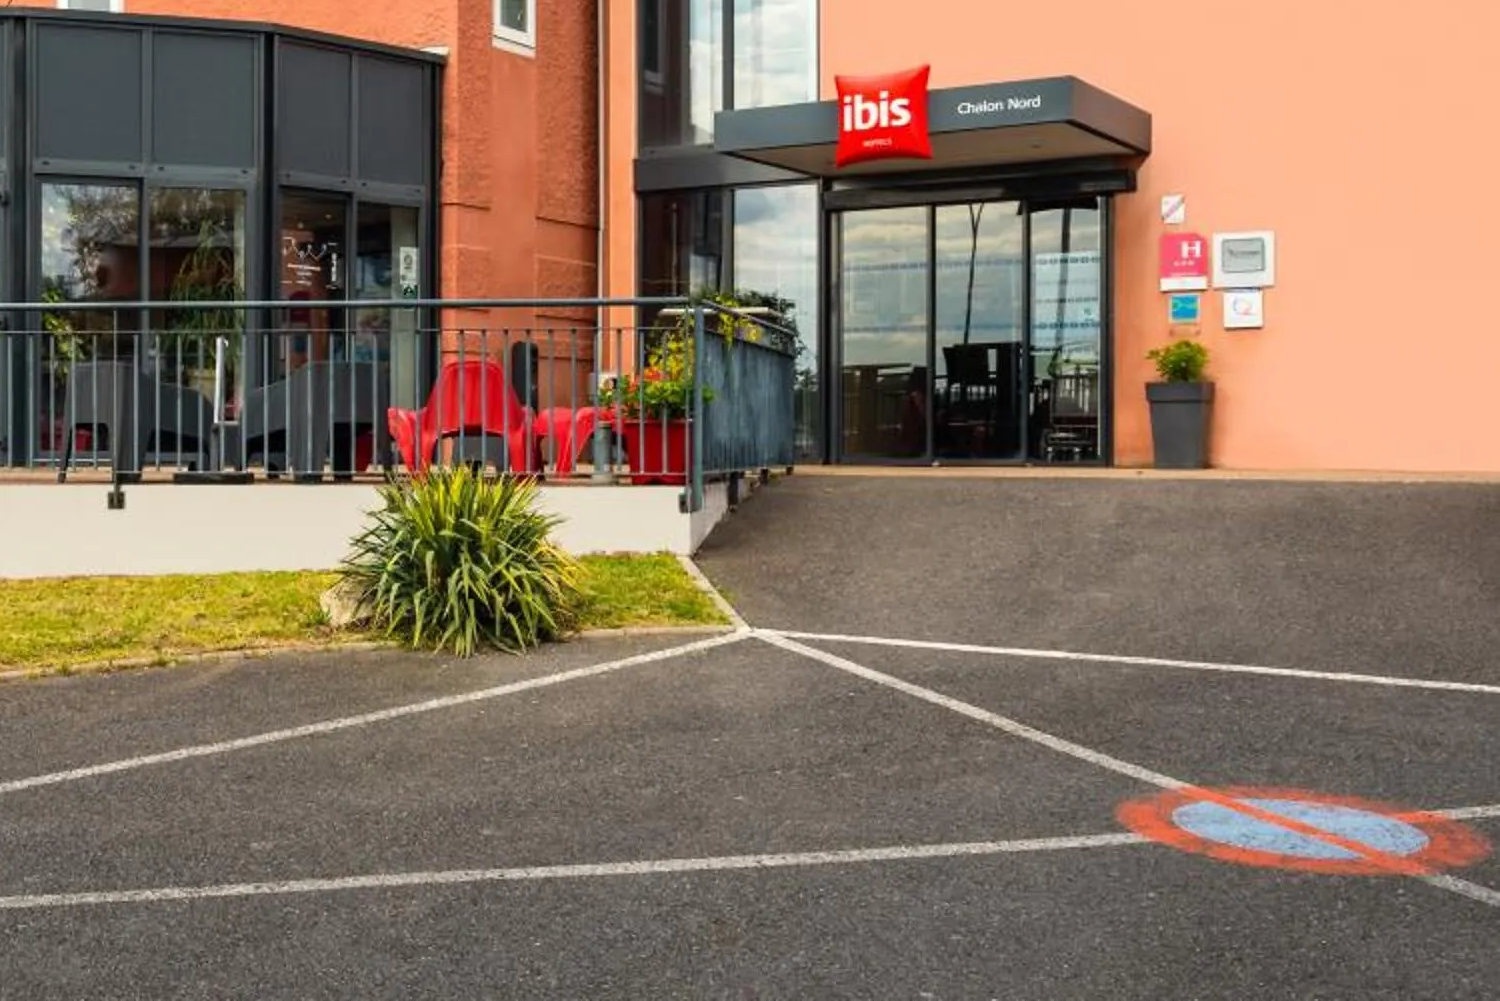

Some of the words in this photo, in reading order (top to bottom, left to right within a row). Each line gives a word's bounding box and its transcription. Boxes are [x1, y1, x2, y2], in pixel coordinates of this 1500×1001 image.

[843, 89, 911, 132] ibis
[957, 99, 1004, 114] Chalon
[1007, 94, 1041, 110] Nord
[1181, 240, 1201, 259] H
